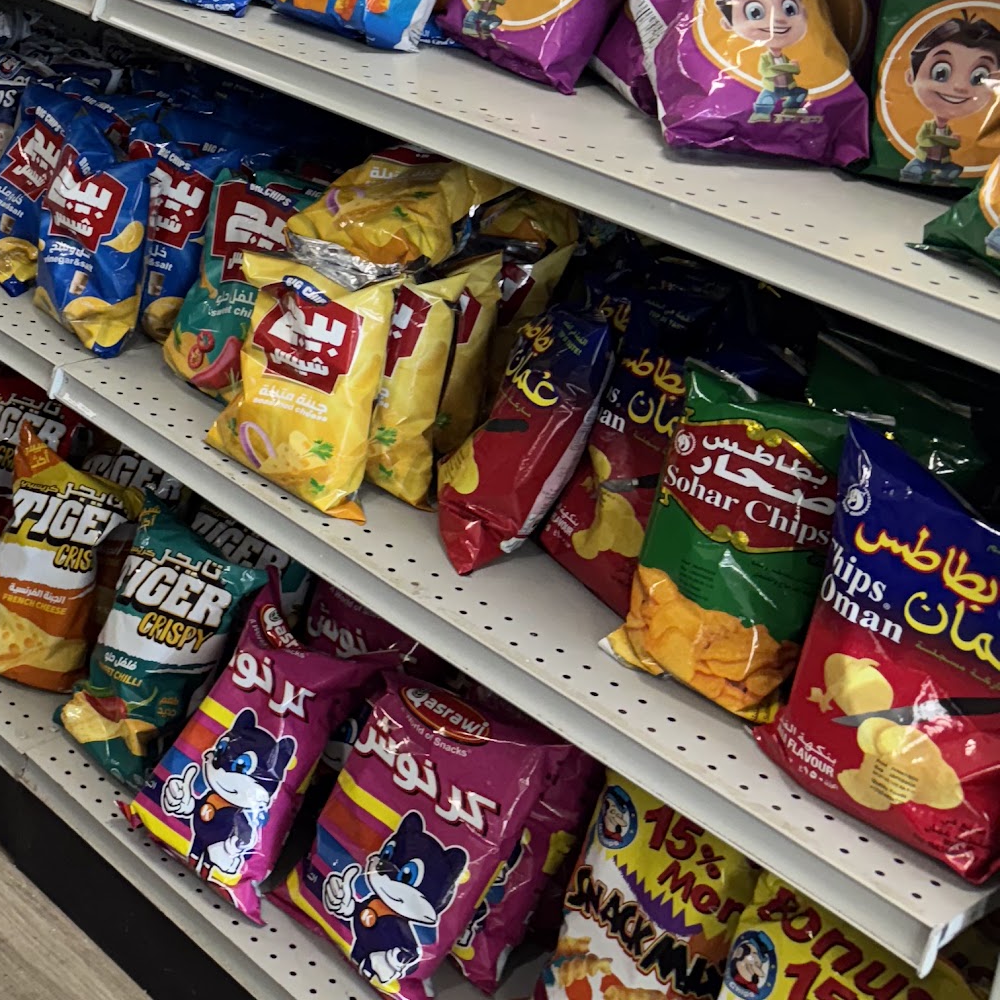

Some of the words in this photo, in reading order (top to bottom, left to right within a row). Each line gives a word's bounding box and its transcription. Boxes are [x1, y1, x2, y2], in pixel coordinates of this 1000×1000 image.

[157, 147, 170, 160] BIG
[169, 155, 191, 171] CHIPS
[702, 434, 828, 490] بطاطس
[664, 464, 739, 512] Sohar
[745, 500, 832, 546] Chips
[54, 544, 94, 571] CRIS
[832, 536, 887, 602] hips
[854, 522, 999, 614] بطاطس
[2, 594, 35, 608] FRENCH
[36, 602, 68, 615] CHEESE
[820, 573, 903, 644] Oman
[139, 612, 213, 651] CRISPY
[114, 669, 142, 687] CHILLI
[406, 688, 490, 737] Qasrawi
[433, 738, 468, 757] Snacks
[786, 737, 835, 777] FLAVOUR
[644, 804, 725, 879] 15%
[564, 865, 656, 956] SNACK
